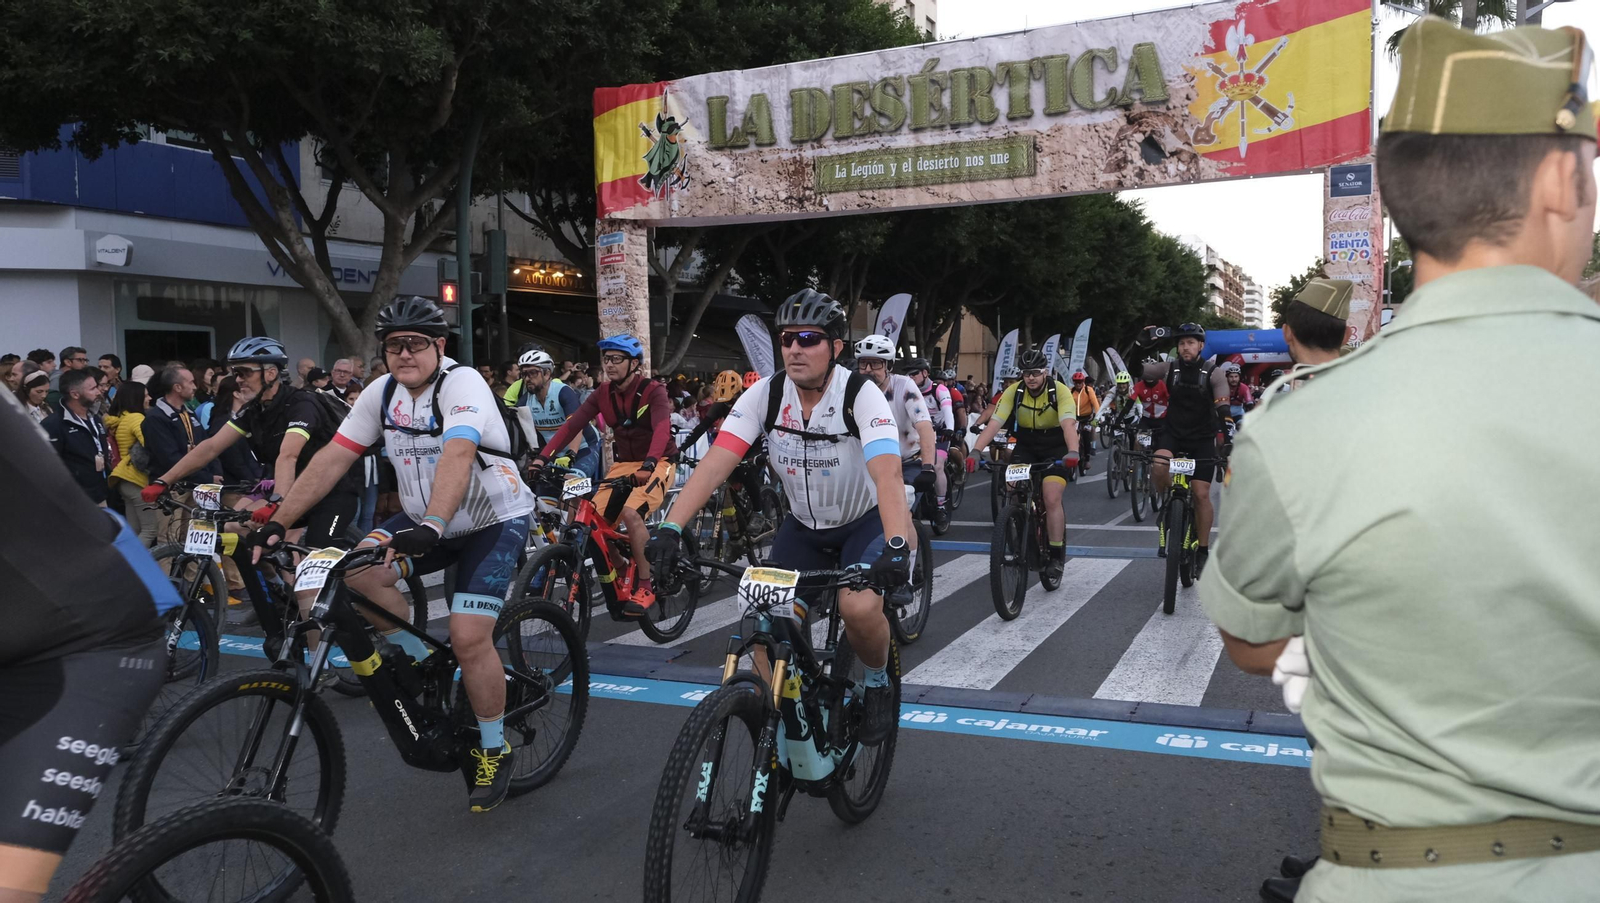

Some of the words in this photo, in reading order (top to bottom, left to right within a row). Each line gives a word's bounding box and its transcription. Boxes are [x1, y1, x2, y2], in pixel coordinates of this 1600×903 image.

[706, 93, 777, 149] LA
[790, 41, 1170, 144] DESÉRTICA
[835, 165, 847, 179] La
[851, 160, 885, 179] Legión
[890, 163, 897, 176] y
[902, 158, 912, 173] el
[917, 155, 960, 171] desierto
[965, 155, 984, 167] nos
[990, 151, 1010, 165] une
[1331, 231, 1369, 239] GRUPO
[1330, 239, 1370, 249] RENTA
[1330, 249, 1370, 261] TODO
[602, 308, 623, 316] BBVA
[394, 448, 405, 457] LA
[778, 454, 789, 465] LA
[1172, 461, 1194, 469] 10070
[1008, 467, 1027, 475] 10021
[189, 531, 214, 545] 10121
[744, 582, 791, 606] 10057
[463, 600, 474, 608] LA
[237, 681, 291, 691] MAXXIS
[394, 699, 420, 741] ORBEA
[956, 717, 1109, 737] cajamar
[695, 761, 714, 803] FOX
[750, 770, 770, 814] FOX
